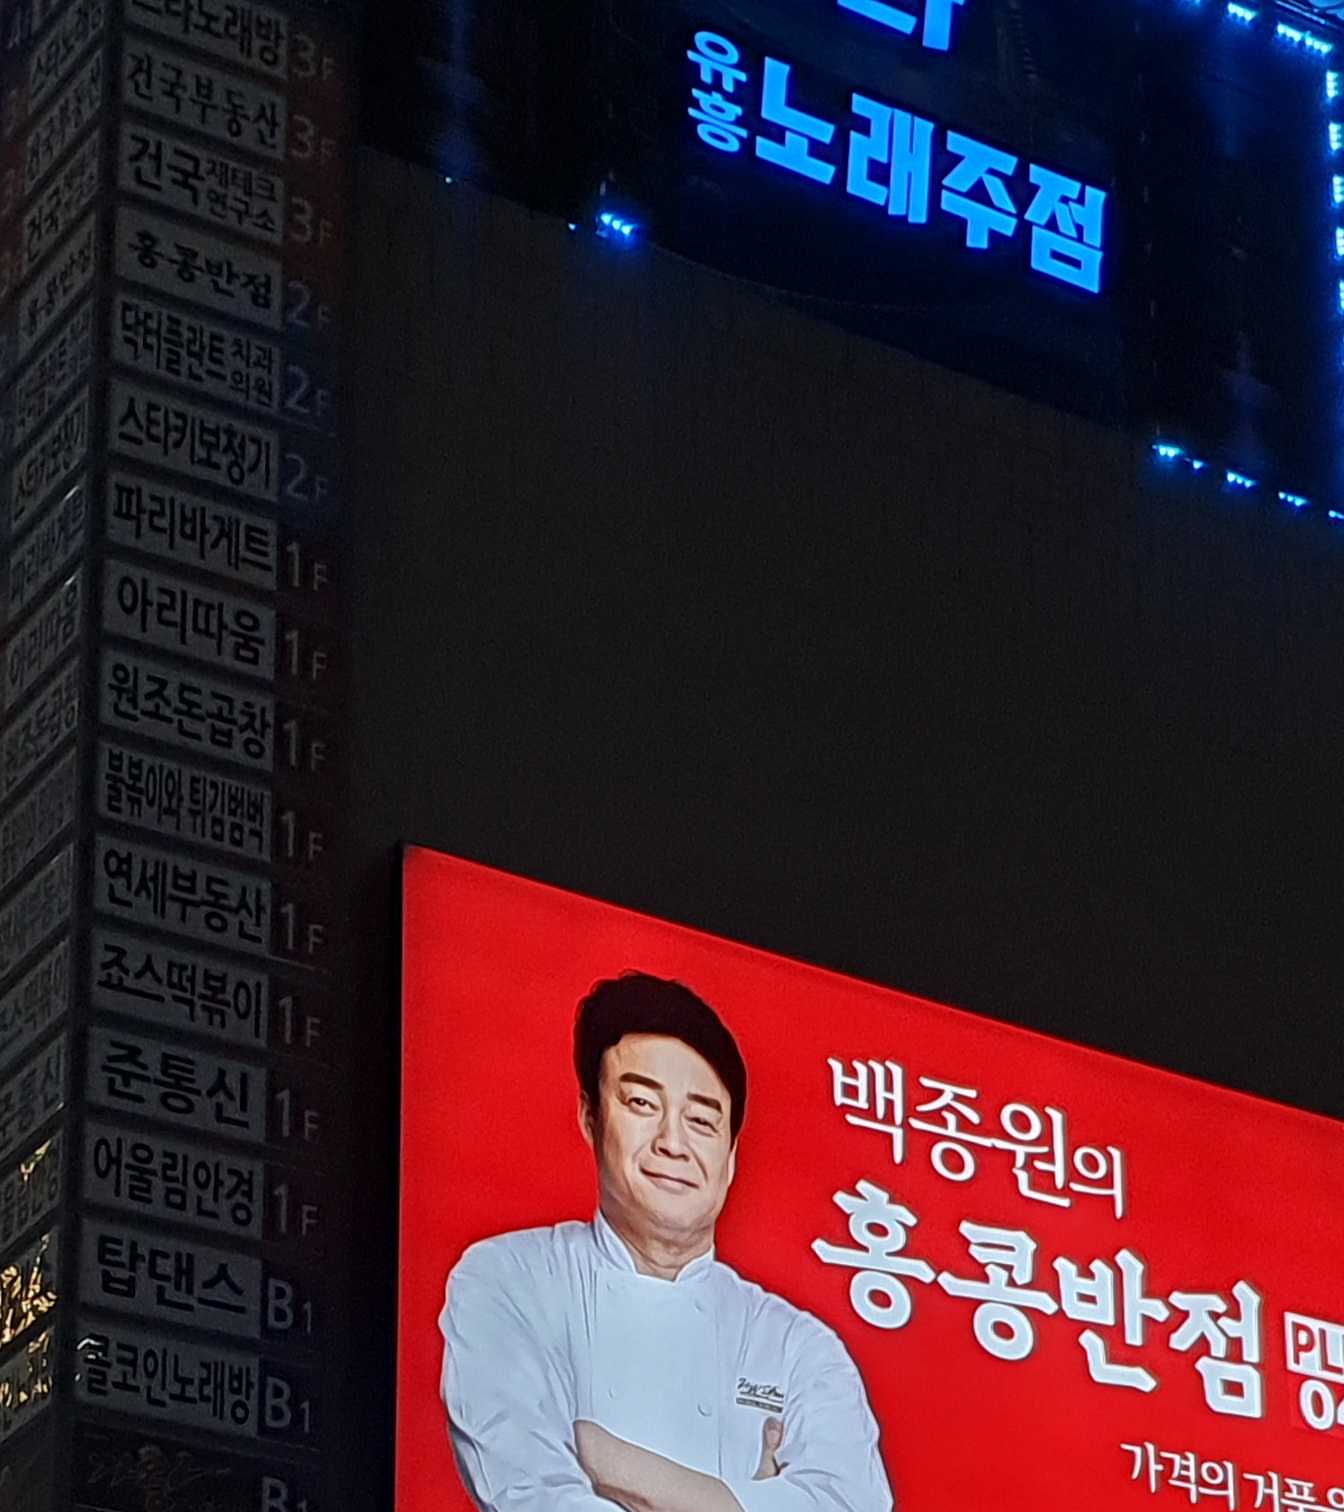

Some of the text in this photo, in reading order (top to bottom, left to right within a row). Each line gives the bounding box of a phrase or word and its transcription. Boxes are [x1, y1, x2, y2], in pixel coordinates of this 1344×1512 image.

[131, 0, 283, 66] 타노래방
[290, 33, 334, 80] 3F
[685, 28, 751, 159] 유흥
[129, 134, 204, 205] 건국
[290, 114, 336, 164] 3F
[753, 53, 1114, 297] 노래주점
[288, 197, 334, 245] 3F
[128, 230, 273, 310] 홍콩반점
[285, 281, 330, 329] 2F
[285, 365, 334, 416] 2F
[119, 396, 272, 489] 스타키보청기
[284, 453, 331, 501] 2F
[113, 483, 273, 572] 파리바게트
[286, 542, 329, 591] 1F
[118, 575, 265, 666] 아리따움
[284, 630, 328, 679] 1F
[108, 663, 272, 759] 원조돈곱창
[283, 719, 327, 771] 1F
[280, 811, 324, 860] 1F
[103, 849, 264, 942] 연세부동산
[280, 902, 324, 954] 1F
[97, 944, 263, 1038] 죠스떡볶이
[278, 995, 322, 1048] 1F
[101, 1041, 250, 1127] 준통신
[275, 1088, 320, 1141] 1F
[826, 1056, 1125, 1220] 백종원의
[94, 1136, 253, 1226] 어울림안경
[272, 1184, 320, 1237] 1F
[98, 1235, 246, 1314] 탑댄스
[266, 1278, 315, 1334] B1
[812, 1179, 1263, 1419] 홍콩반점
[262, 1376, 312, 1435] B1
[1120, 1441, 1236, 1511] 가격의
